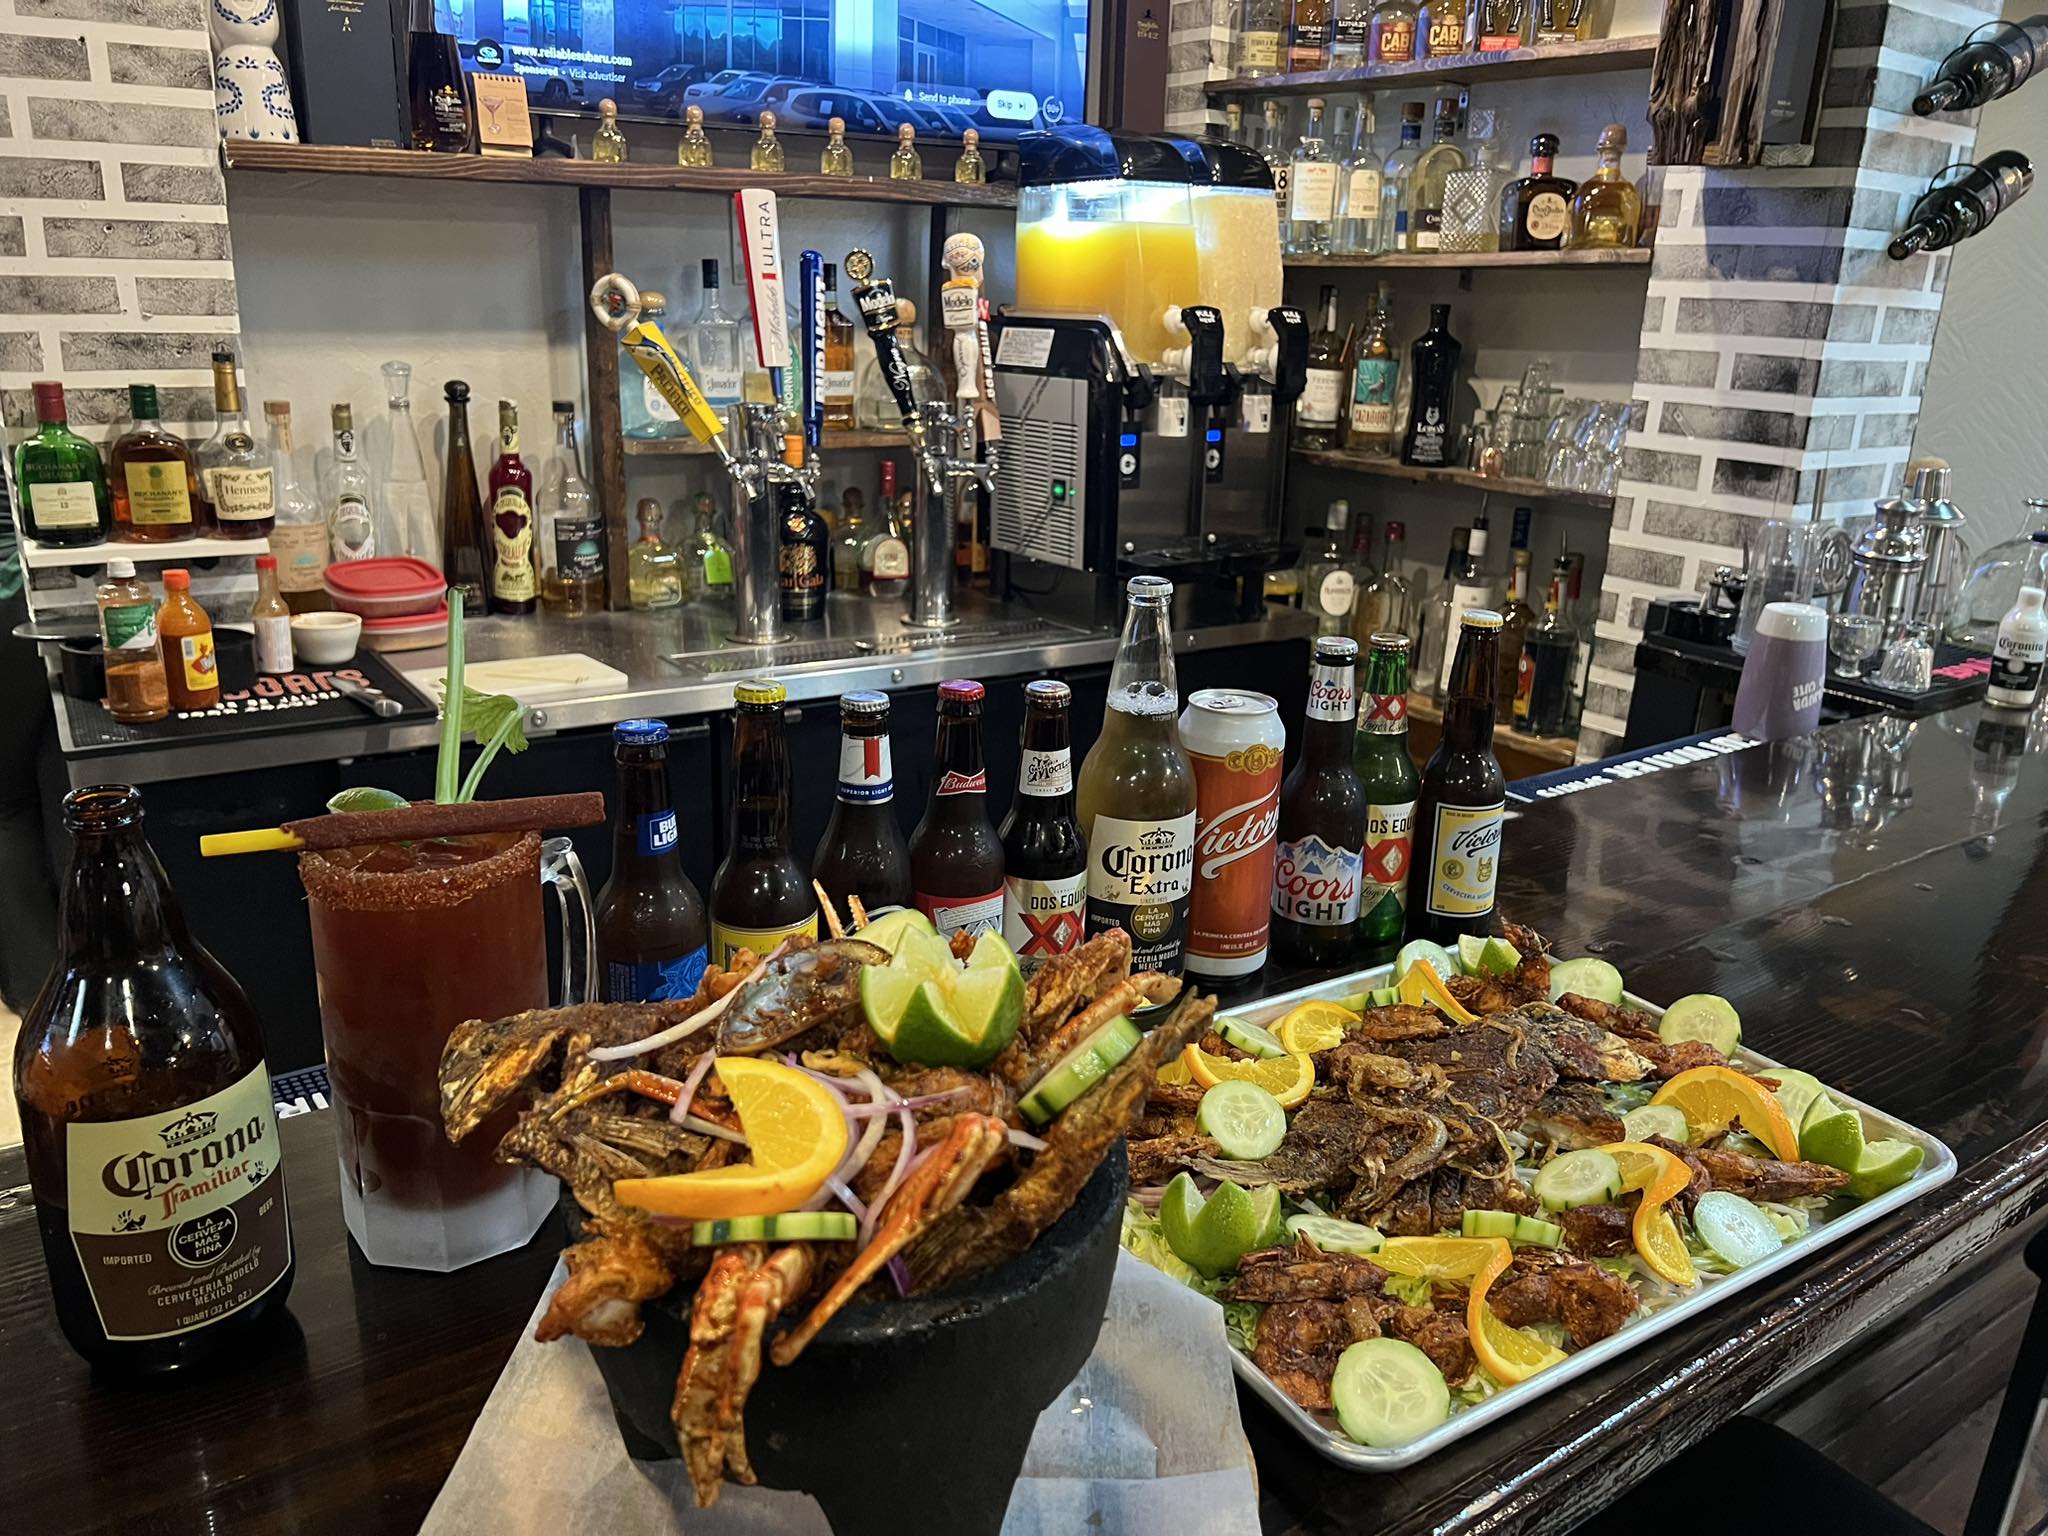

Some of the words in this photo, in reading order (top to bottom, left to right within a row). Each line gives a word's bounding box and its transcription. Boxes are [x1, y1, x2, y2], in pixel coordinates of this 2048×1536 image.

[512, 45, 632, 67] www.reliablesubaru.com
[513, 62, 559, 76] Sponsored
[588, 71, 626, 83] advertiser
[918, 91, 938, 102] Send
[939, 94, 948, 103] to
[948, 97, 972, 106] phone
[997, 99, 1013, 110] Skip
[759, 201, 777, 267] ULTRA
[860, 293, 896, 312] Modelo
[943, 296, 974, 307] Modelo
[225, 484, 269, 497] Hennessy
[1999, 637, 2044, 651] Coronita
[1310, 679, 1353, 700] Coors
[1310, 700, 1349, 712] LIGHT
[841, 787, 869, 796] SUPERIOR
[872, 787, 887, 796] LIGHT
[1102, 844, 1193, 882] Corona
[1129, 876, 1178, 895] Extra
[1275, 859, 1354, 901] Coors
[1031, 896, 1056, 910] DOS
[1061, 886, 1086, 908] EQUIS
[1443, 883, 1477, 900] CERVECERIA
[1135, 912, 1169, 921] CERVEZA
[1277, 898, 1347, 921] LIGHT
[1091, 913, 1120, 927] IMPORTED
[1144, 920, 1160, 928] MAS
[1143, 927, 1161, 935] FINA
[1229, 931, 1253, 939] CERVEZA
[1138, 961, 1163, 970] MEXICO
[102, 1115, 264, 1200] Corona
[160, 1160, 250, 1221] Familiar
[258, 1197, 273, 1216] BEER
[178, 1219, 232, 1244] CERVEZA
[197, 1218, 213, 1230] LA
[195, 1233, 221, 1248] MAS
[195, 1242, 222, 1258] FINA
[103, 1253, 152, 1266] IMPORTED
[147, 1276, 194, 1296] Brewed
[194, 1268, 215, 1285] and
[216, 1249, 251, 1276] Bottled
[157, 1279, 223, 1307] CERVECERIA
[225, 1258, 260, 1283] MODELO
[195, 1284, 233, 1307] MEXICO
[183, 1310, 208, 1325] QUART
